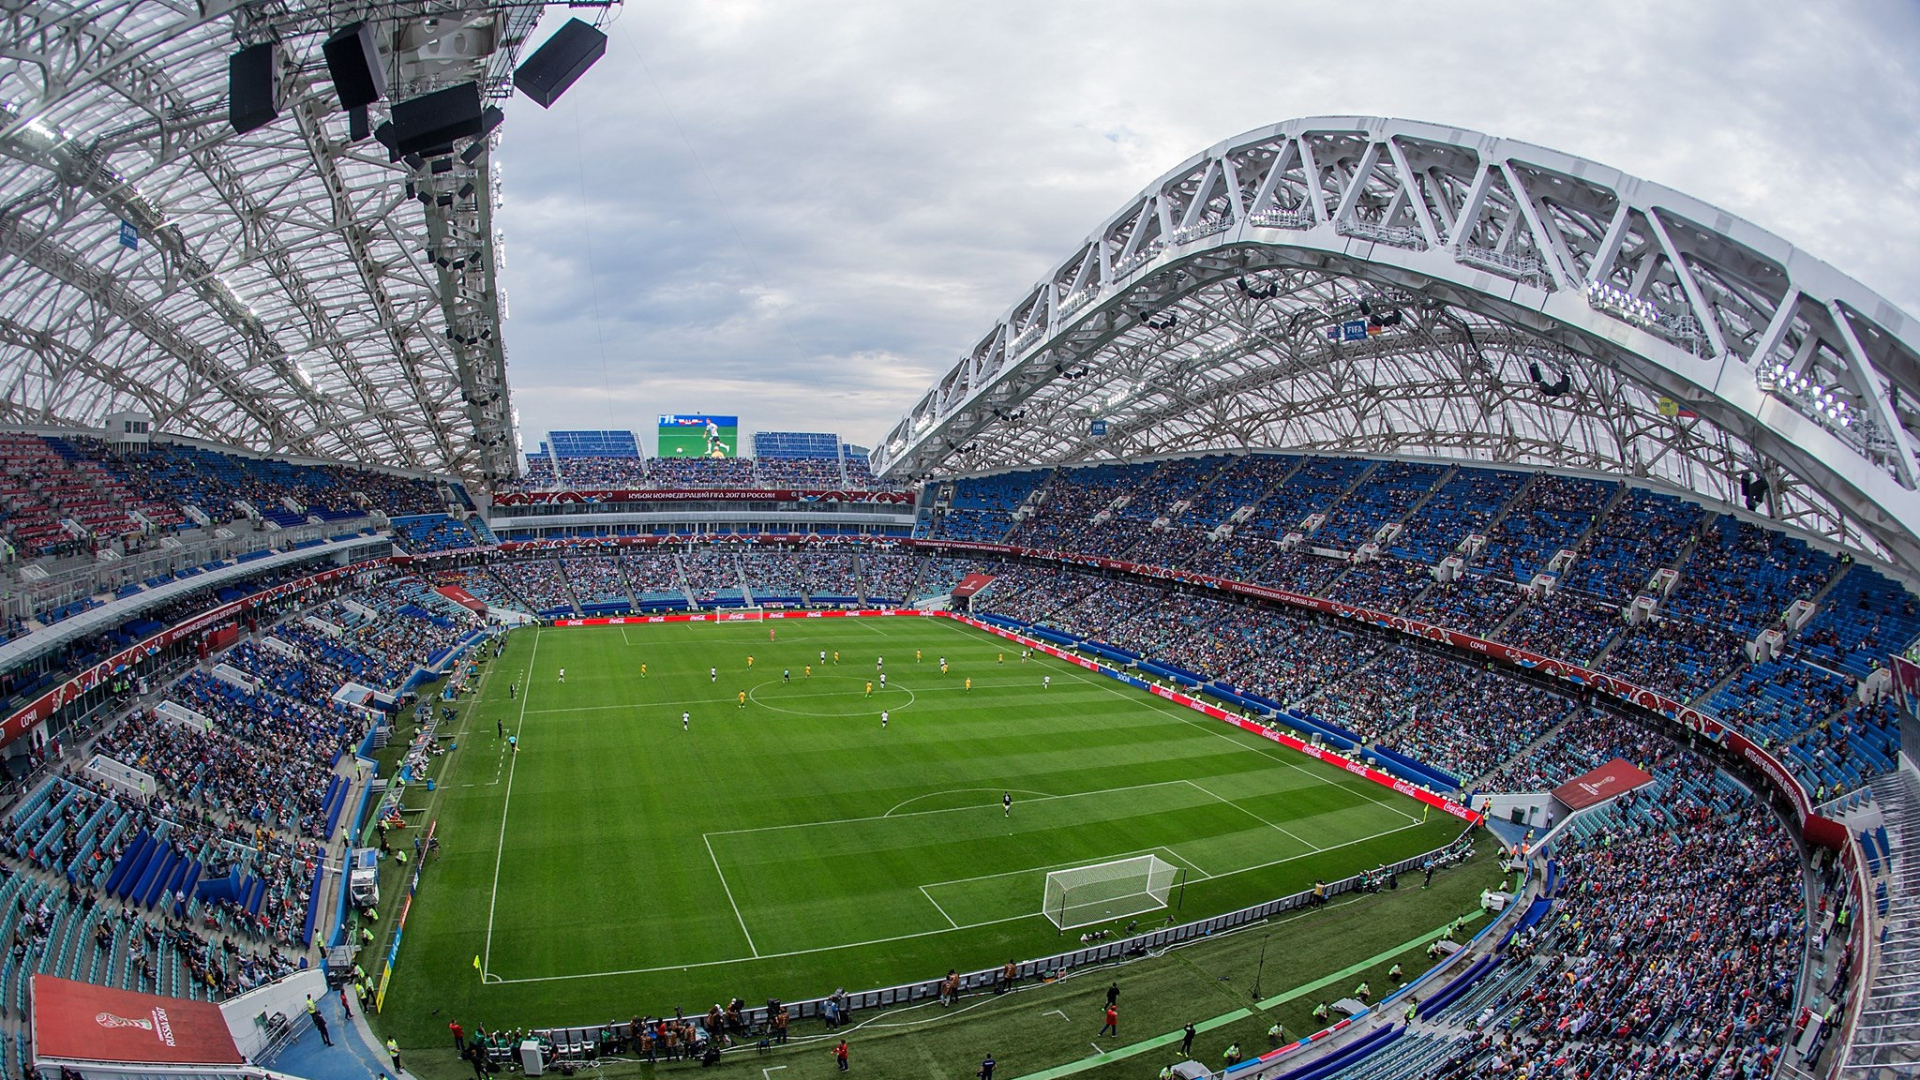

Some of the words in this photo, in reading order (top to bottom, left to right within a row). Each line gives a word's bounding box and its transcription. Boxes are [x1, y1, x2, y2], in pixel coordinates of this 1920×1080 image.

[1347, 326, 1363, 334] FIFA
[1242, 586, 1280, 599] CONFEDERATIONS
[1290, 596, 1308, 606] RUSSIA
[1470, 641, 1486, 651] СОЧИ
[1117, 673, 1130, 683] SOCHI
[21, 709, 37, 728] СОЧИ
[1262, 728, 1280, 742] Coca-Cola
[1302, 744, 1321, 759] Coca-Cola
[1346, 762, 1367, 777] Coca-Cola
[1393, 781, 1416, 797] Coca-Cola
[1444, 802, 1468, 819] Coca-Cola
[156, 1006, 168, 1021] 2017
[161, 1021, 176, 1046] RUSSIA
